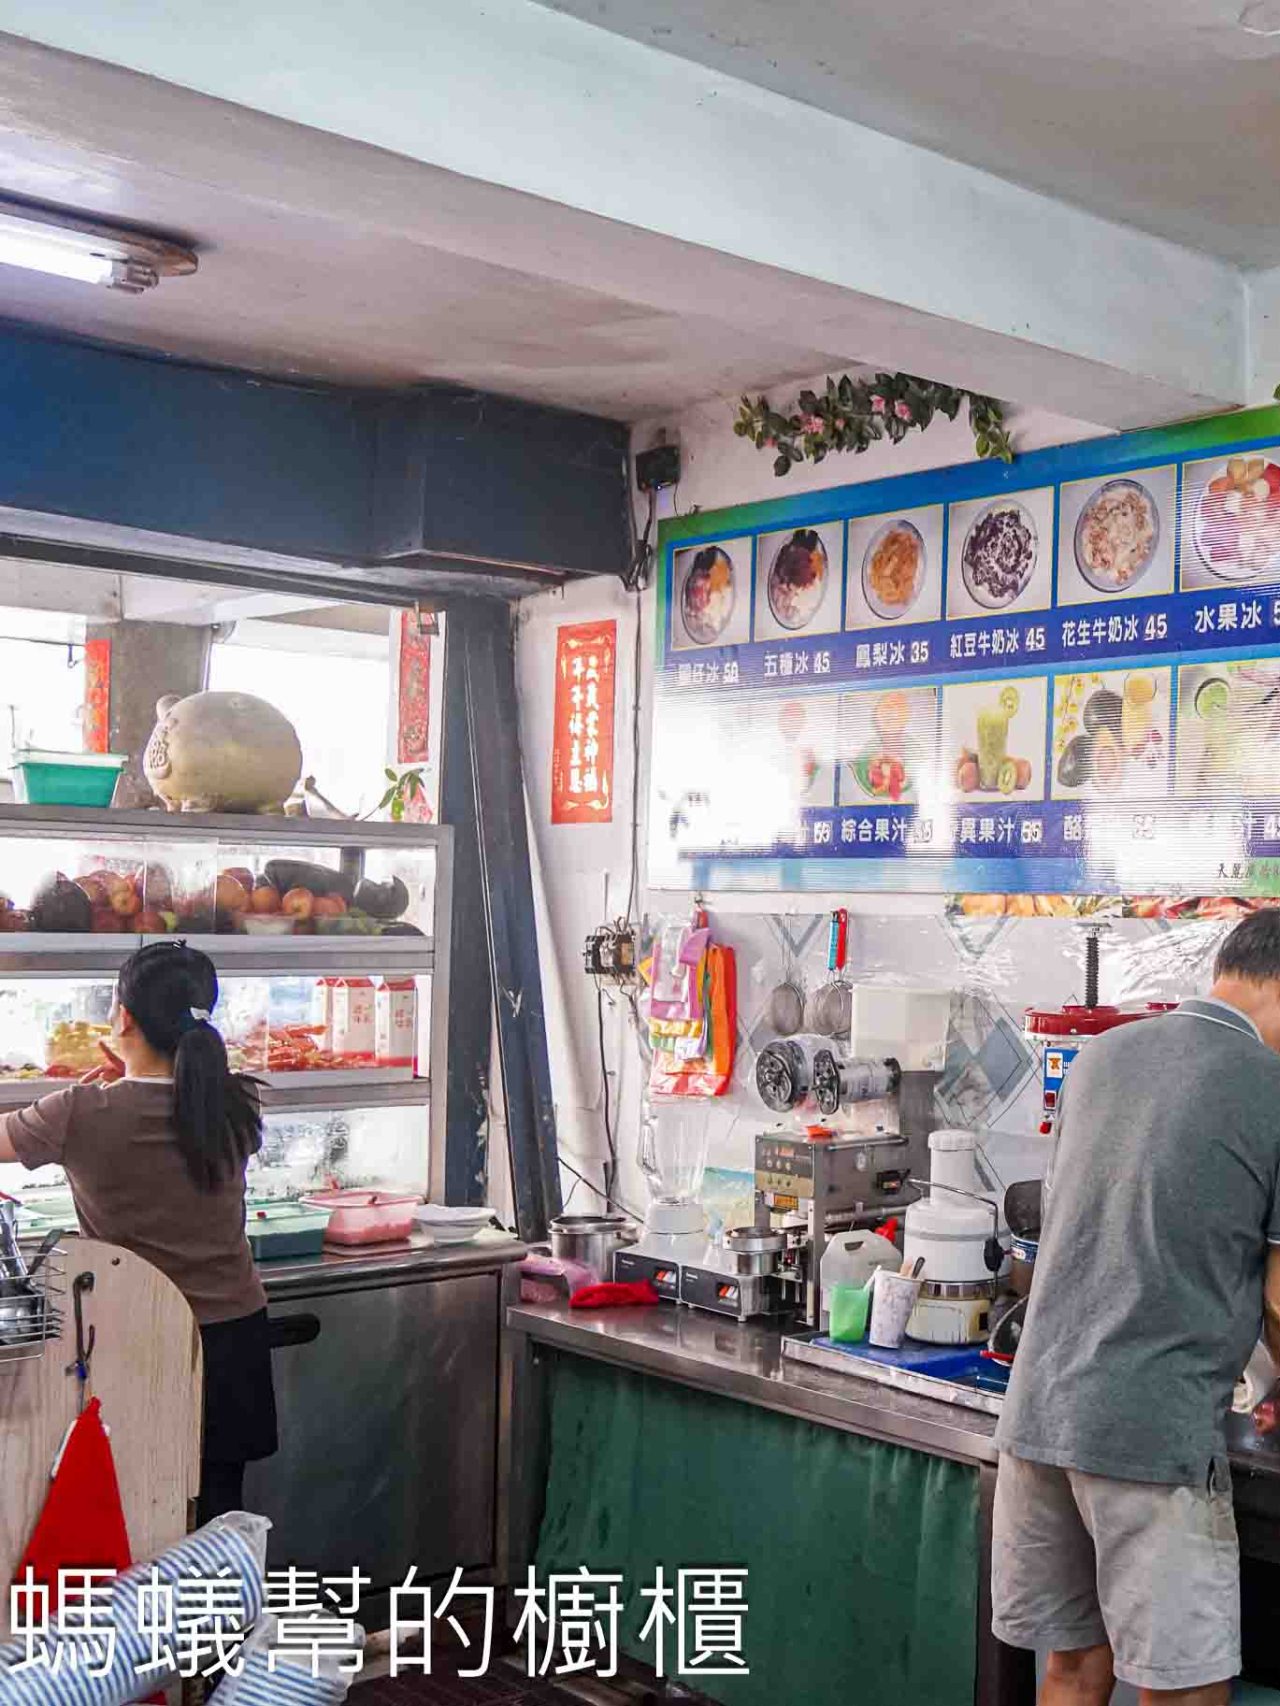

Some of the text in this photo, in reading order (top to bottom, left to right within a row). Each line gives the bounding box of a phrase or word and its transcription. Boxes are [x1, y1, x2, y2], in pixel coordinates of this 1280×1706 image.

[1061, 613, 1168, 648] 花生牛奶冰 45
[1194, 600, 1263, 634] 水果冰
[855, 641, 929, 668] 鳳梨冰 35
[950, 627, 1046, 659] 紅豆牛奶冰 45
[763, 651, 809, 677] 五種冰
[841, 817, 906, 844] 綜合果汁
